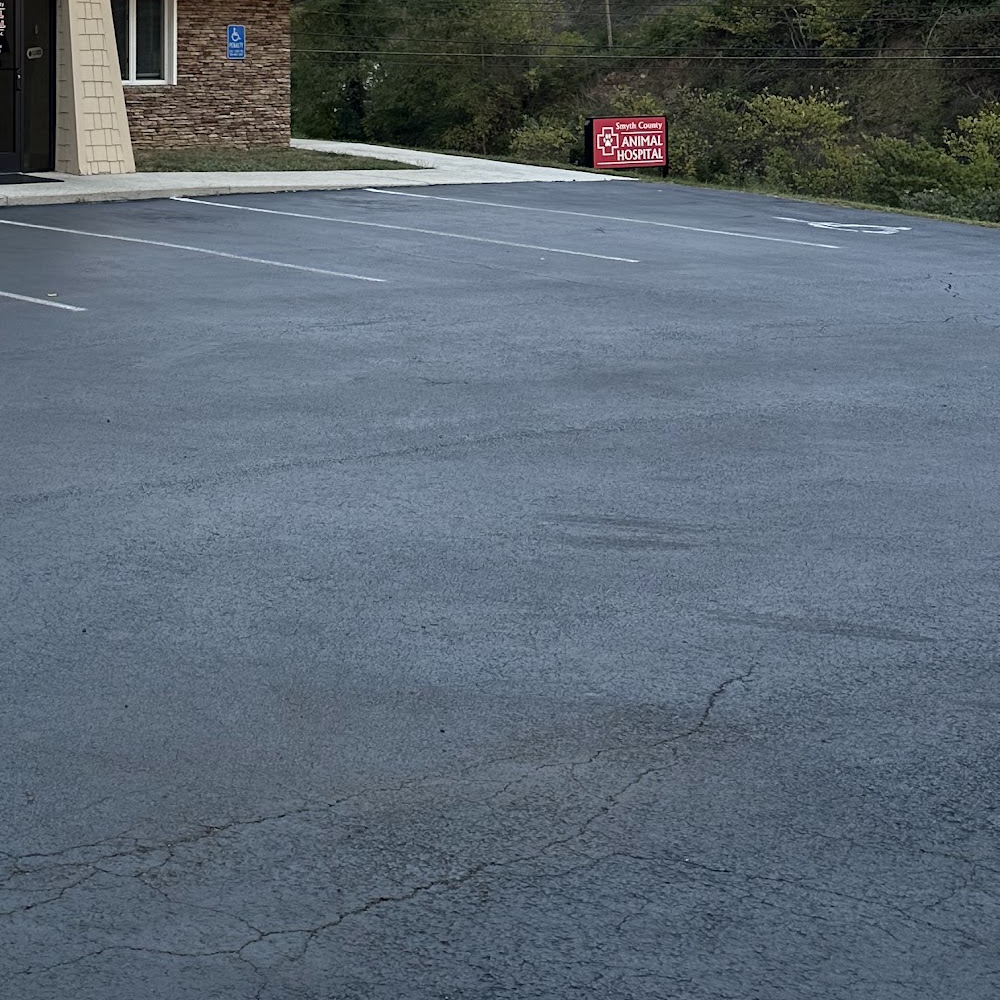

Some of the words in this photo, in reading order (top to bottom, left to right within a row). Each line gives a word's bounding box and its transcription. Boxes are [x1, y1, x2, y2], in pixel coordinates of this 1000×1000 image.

[616, 122, 636, 130] Smyth
[638, 121, 662, 129] County
[621, 135, 663, 147] ANIMAL
[617, 148, 663, 161] HOSPITAL
